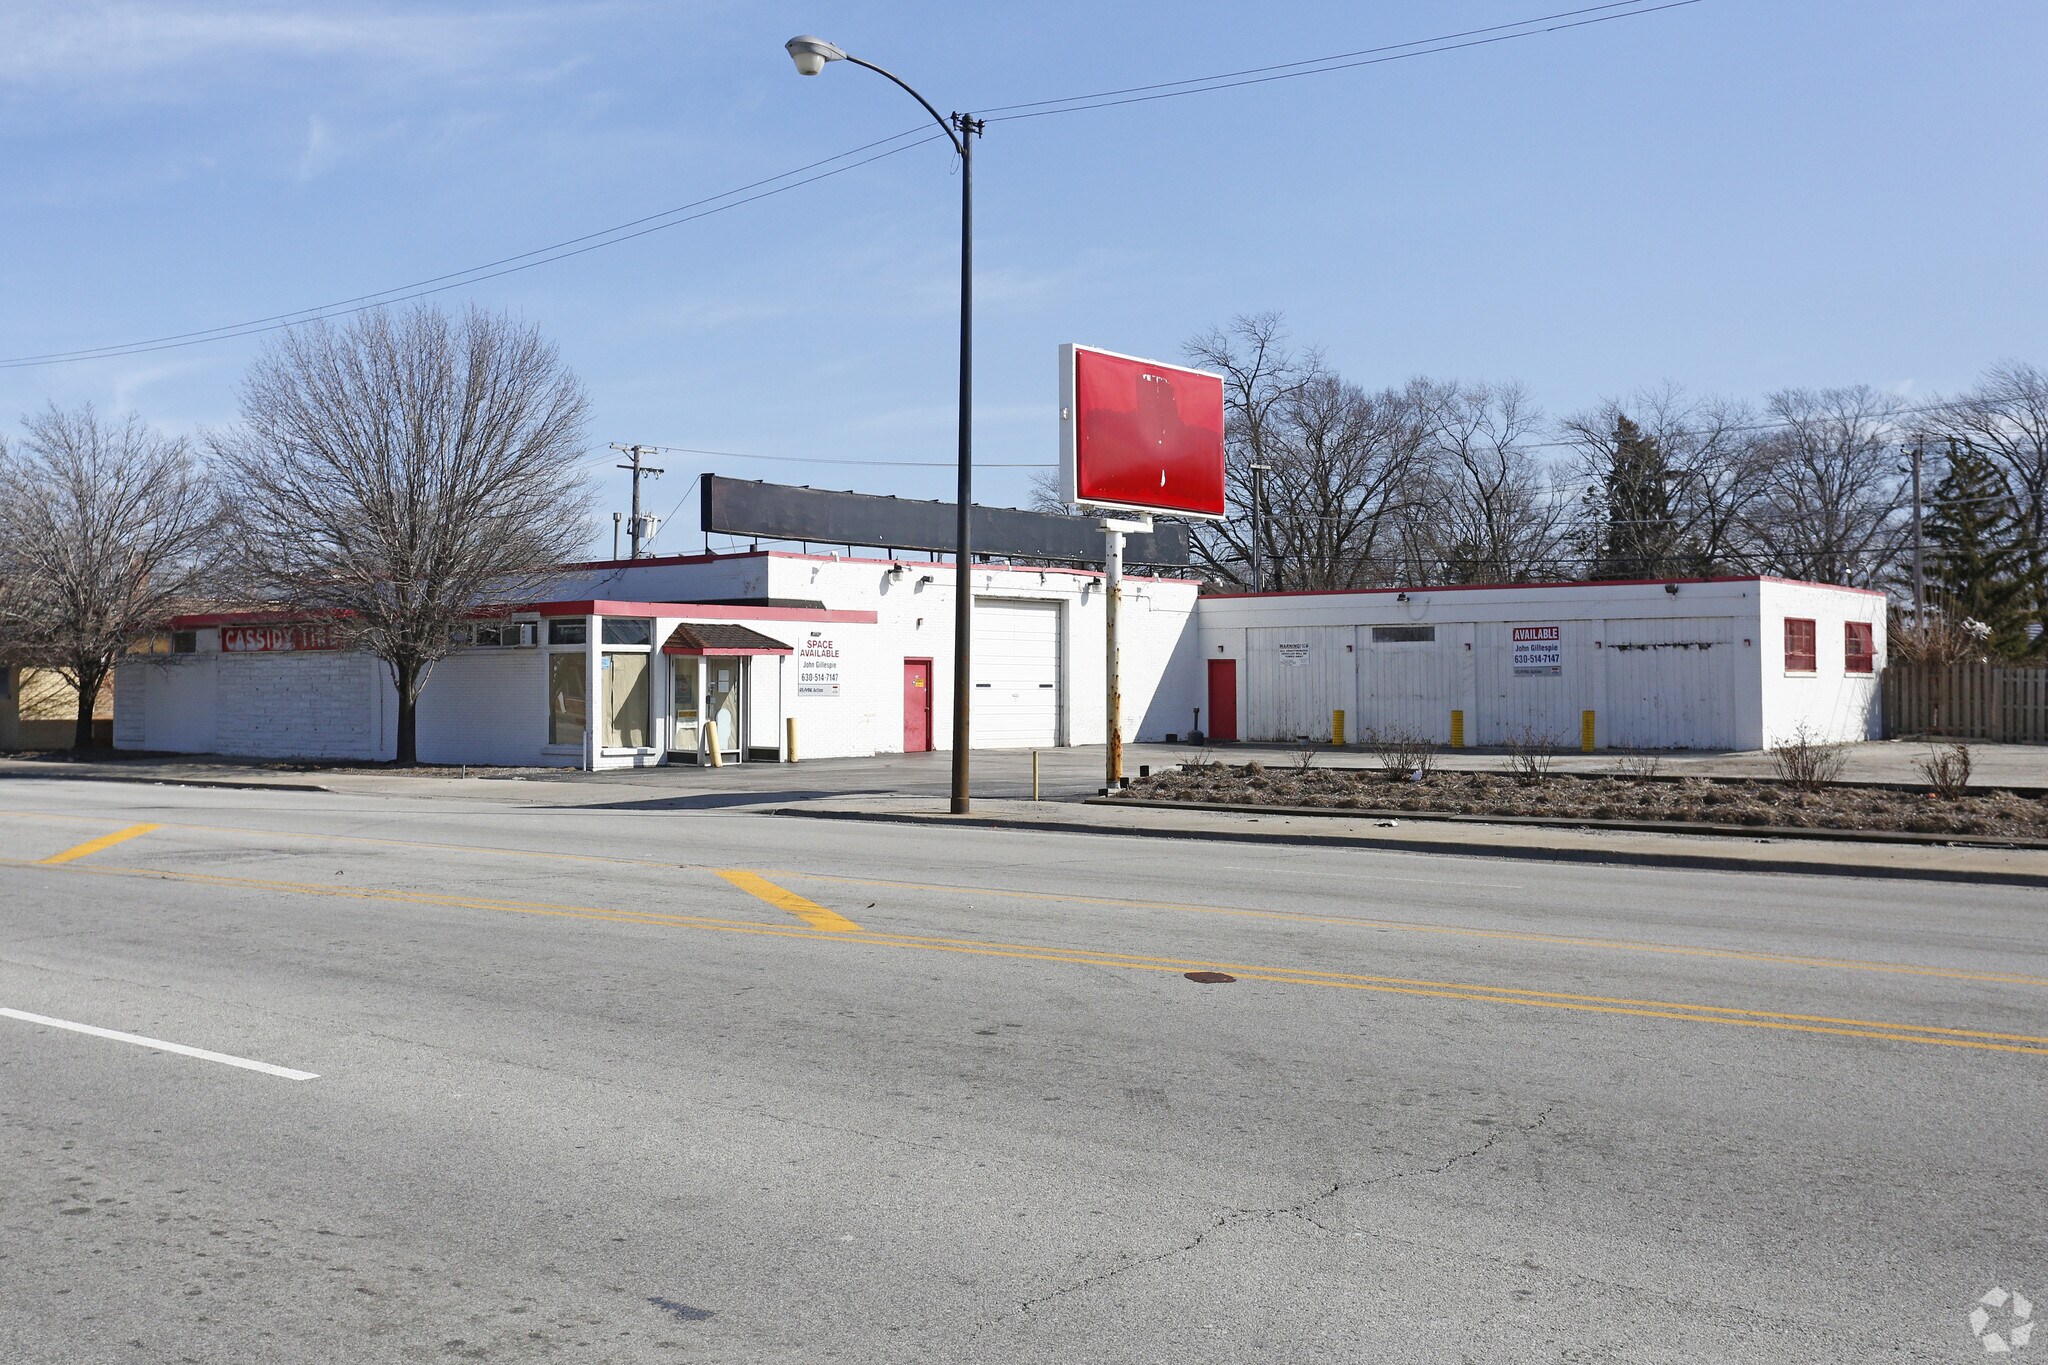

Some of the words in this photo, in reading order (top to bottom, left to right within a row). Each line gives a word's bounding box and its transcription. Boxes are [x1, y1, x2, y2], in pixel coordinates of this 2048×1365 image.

[1515, 629, 1557, 640] AVAILABLE
[807, 640, 833, 649] SPACE
[1531, 644, 1558, 652] Gillespie
[1515, 654, 1559, 663] 630-514-7147
[816, 661, 836, 669] Gillespie
